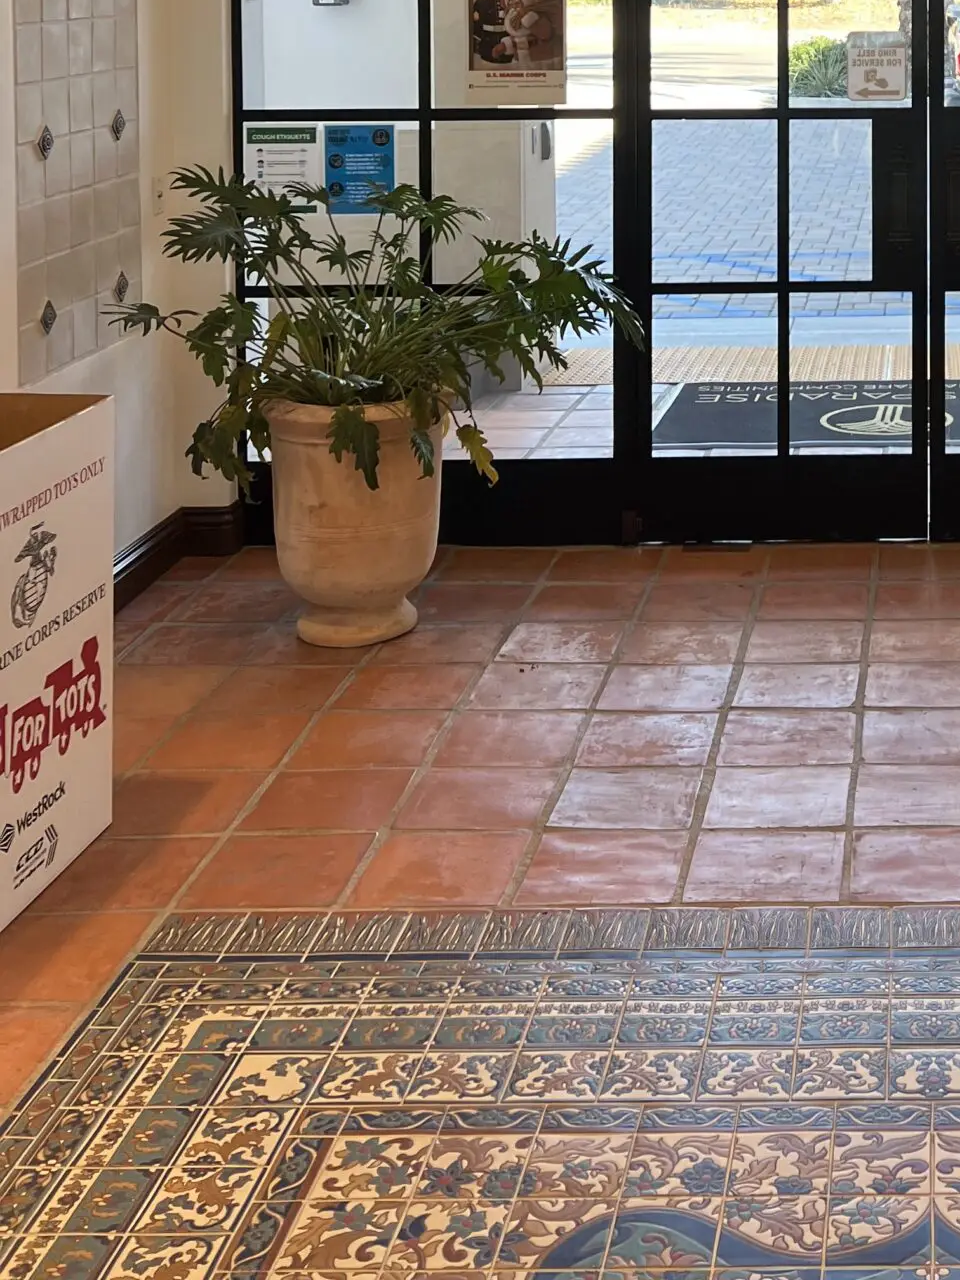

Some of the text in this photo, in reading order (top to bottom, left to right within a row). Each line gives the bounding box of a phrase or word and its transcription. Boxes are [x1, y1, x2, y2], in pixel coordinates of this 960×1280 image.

[53, 472, 79, 500] TOYS
[79, 456, 106, 484] ONLY
[25, 615, 61, 652] CORPS
[62, 583, 106, 626] RESERVE
[12, 713, 46, 758] FOR
[55, 674, 97, 724] TOTS
[16, 780, 66, 835] WestRock
